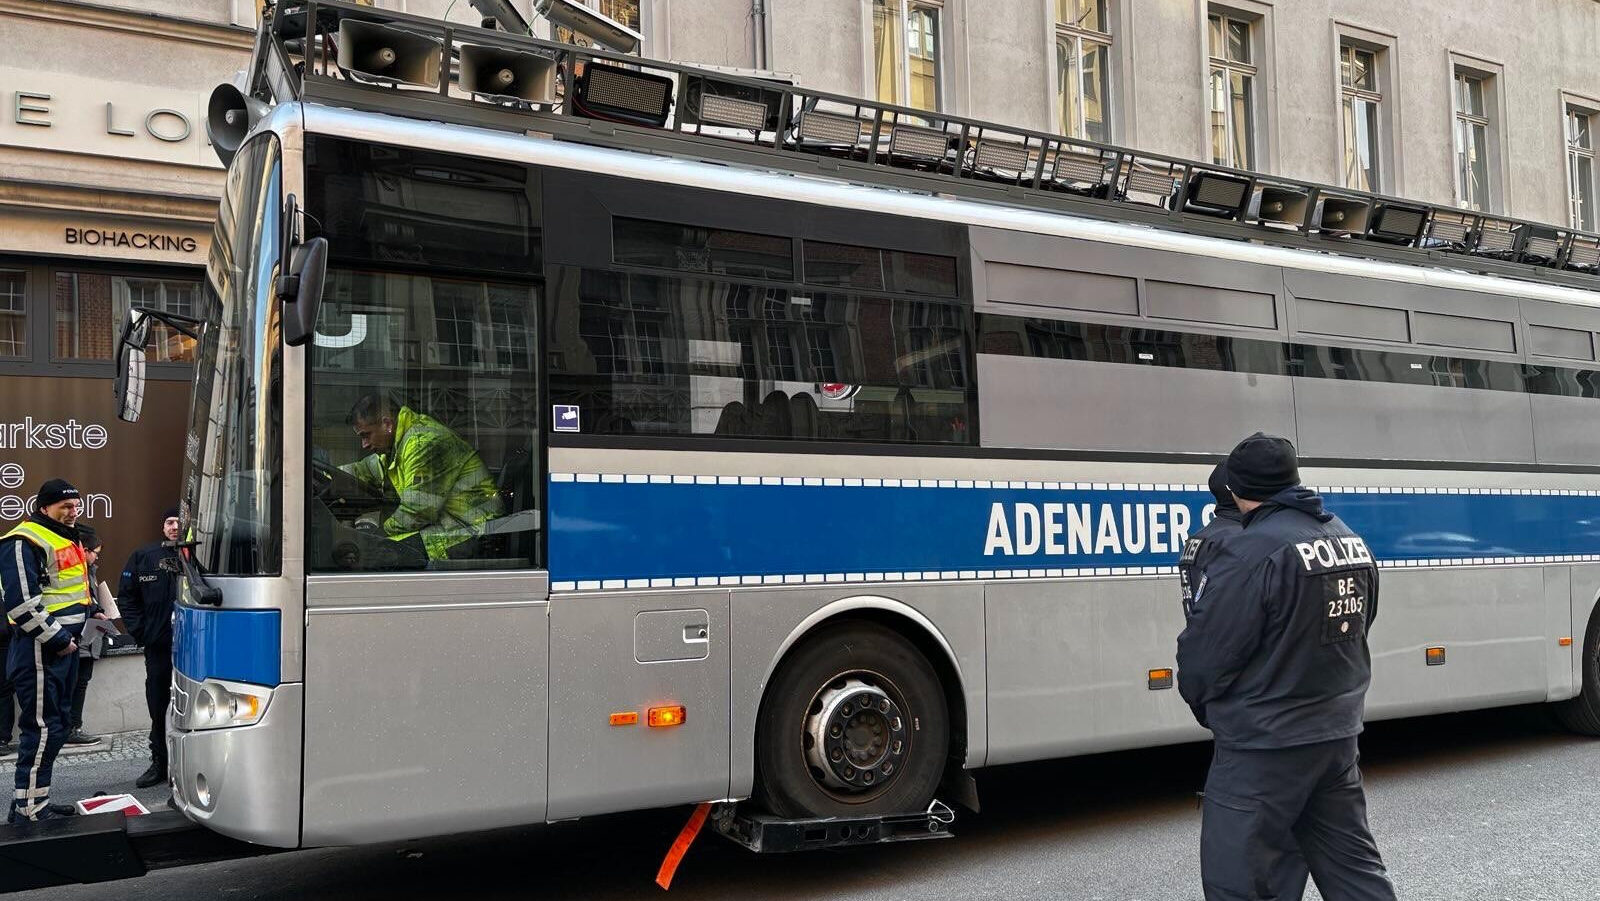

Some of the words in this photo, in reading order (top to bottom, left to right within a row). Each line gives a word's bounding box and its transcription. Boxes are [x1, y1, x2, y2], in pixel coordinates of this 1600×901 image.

[106, 101, 212, 146] LO
[65, 227, 197, 252] BIOHACKING
[984, 502, 1190, 556] ADENAUER
[1338, 577, 1355, 596] BE
[1328, 596, 1364, 618] 23105
